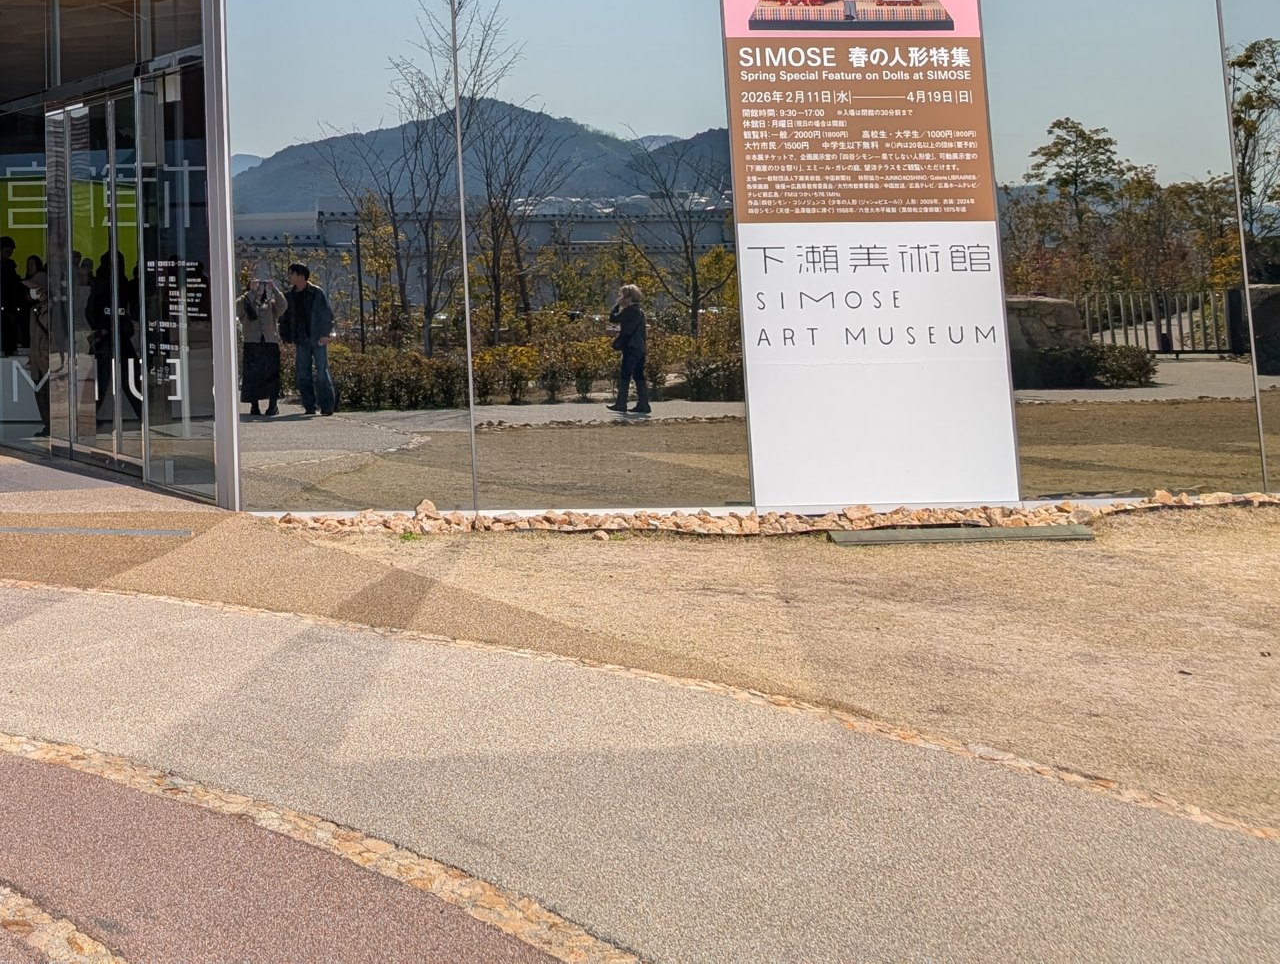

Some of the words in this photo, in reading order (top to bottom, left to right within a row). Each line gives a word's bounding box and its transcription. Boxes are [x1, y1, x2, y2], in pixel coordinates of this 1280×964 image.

[739, 47, 837, 67] SIMOSE
[848, 46, 971, 68] 春の人形特集
[740, 70, 776, 82] Spring
[779, 70, 819, 82] Special
[822, 70, 862, 81] Feature
[865, 72, 879, 80] on
[882, 70, 910, 80] Dolls
[912, 71, 924, 80] at
[927, 70, 971, 80] SIMOSE
[821, 141, 879, 150] 中学生以下無料
[747, 243, 992, 274] 下瀬美術館
[756, 290, 900, 311] SIMOSE
[757, 327, 819, 347] ART
[845, 325, 996, 346] MUSEUM
